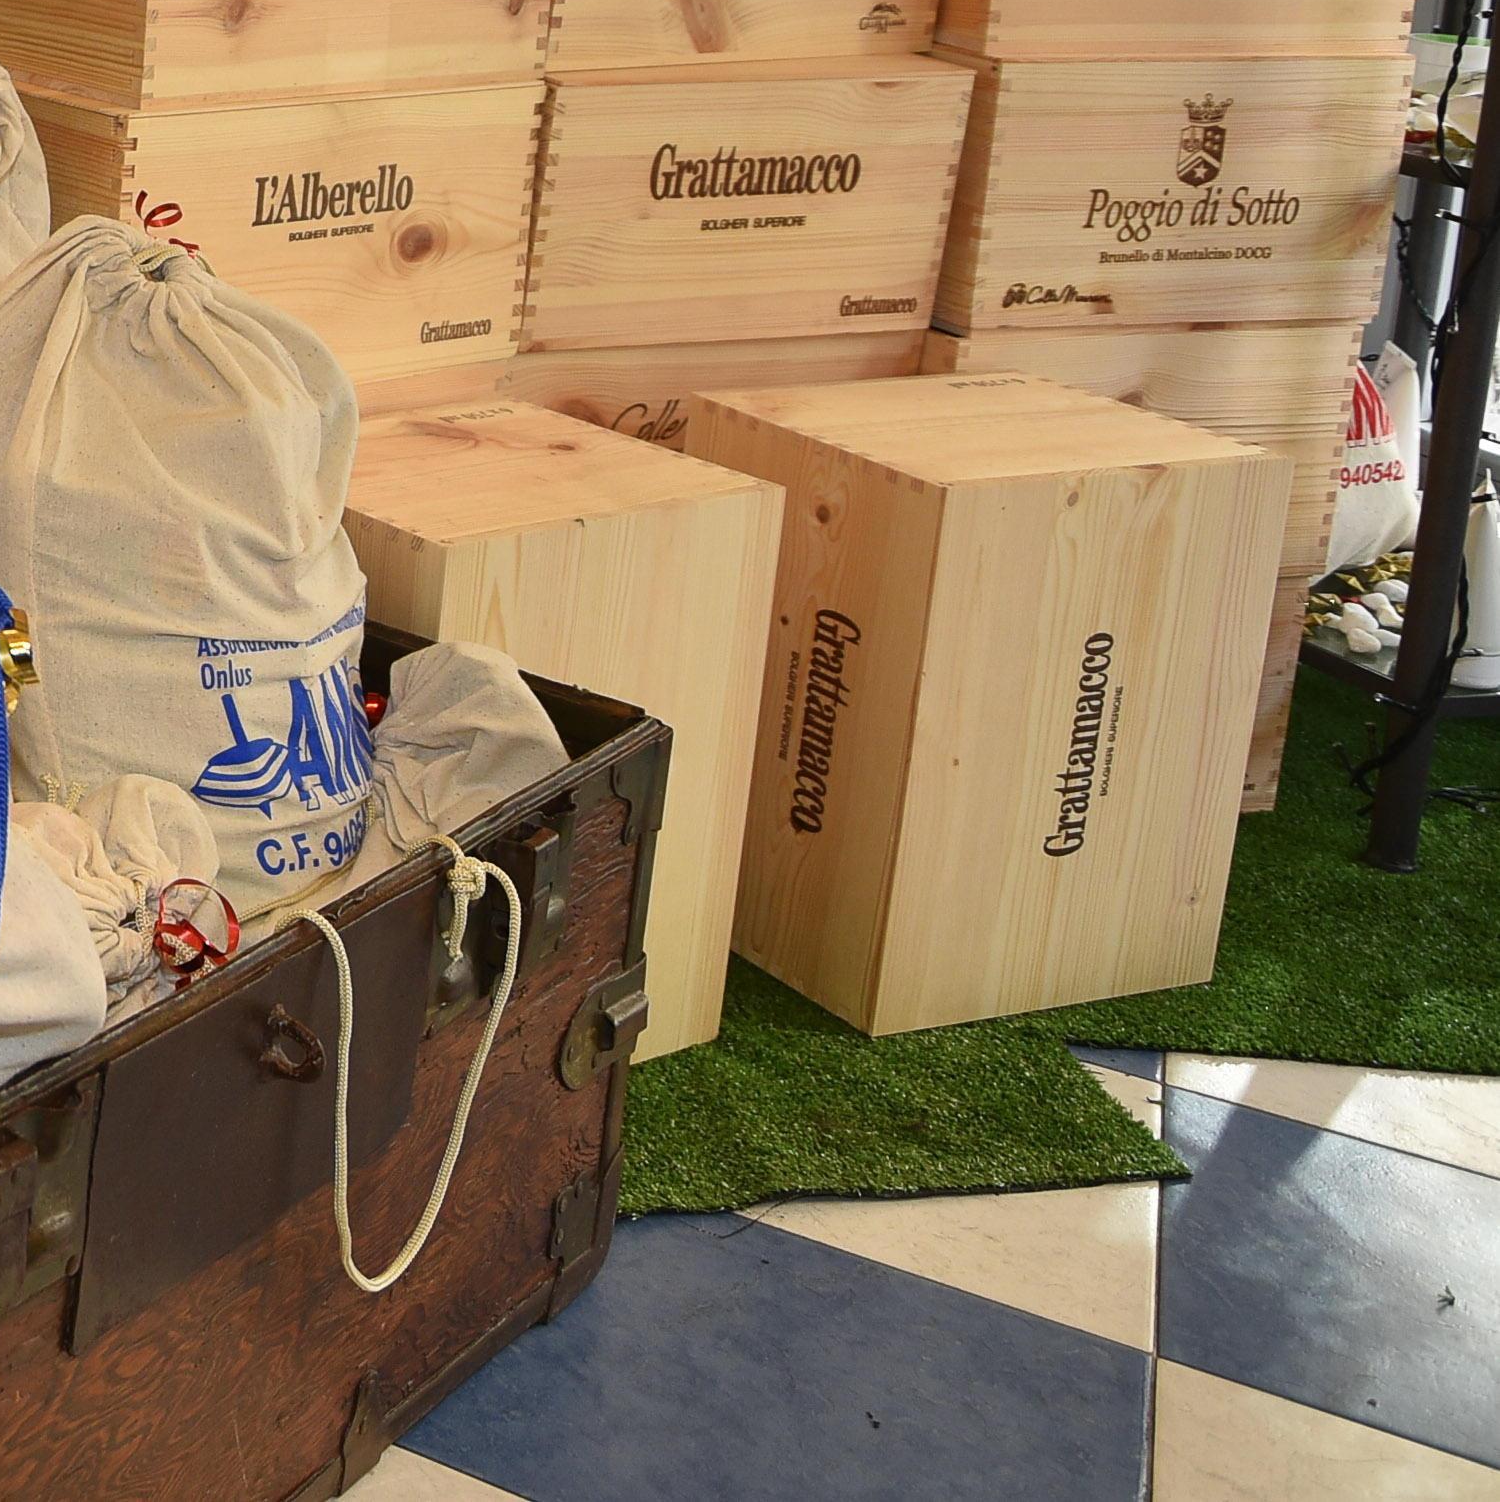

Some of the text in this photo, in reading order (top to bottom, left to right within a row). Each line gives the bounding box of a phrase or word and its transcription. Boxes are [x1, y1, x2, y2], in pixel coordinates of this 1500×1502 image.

[650, 143, 861, 200] Grattamacco
[700, 215, 807, 231] BOLGHERI SUPERIORE
[1082, 186, 1300, 242] Poggio di Sotto
[1099, 249, 1149, 264] Brunello
[1151, 248, 1164, 262] di
[1166, 248, 1232, 262] Montalcino
[839, 295, 917, 317] Grattamacco
[421, 319, 492, 344] Grattamacco
[200, 660, 252, 690] Onlus
[790, 608, 861, 834] Grattamacco
[1043, 632, 1114, 857] Grattamacco
[256, 832, 319, 875] C.F.
